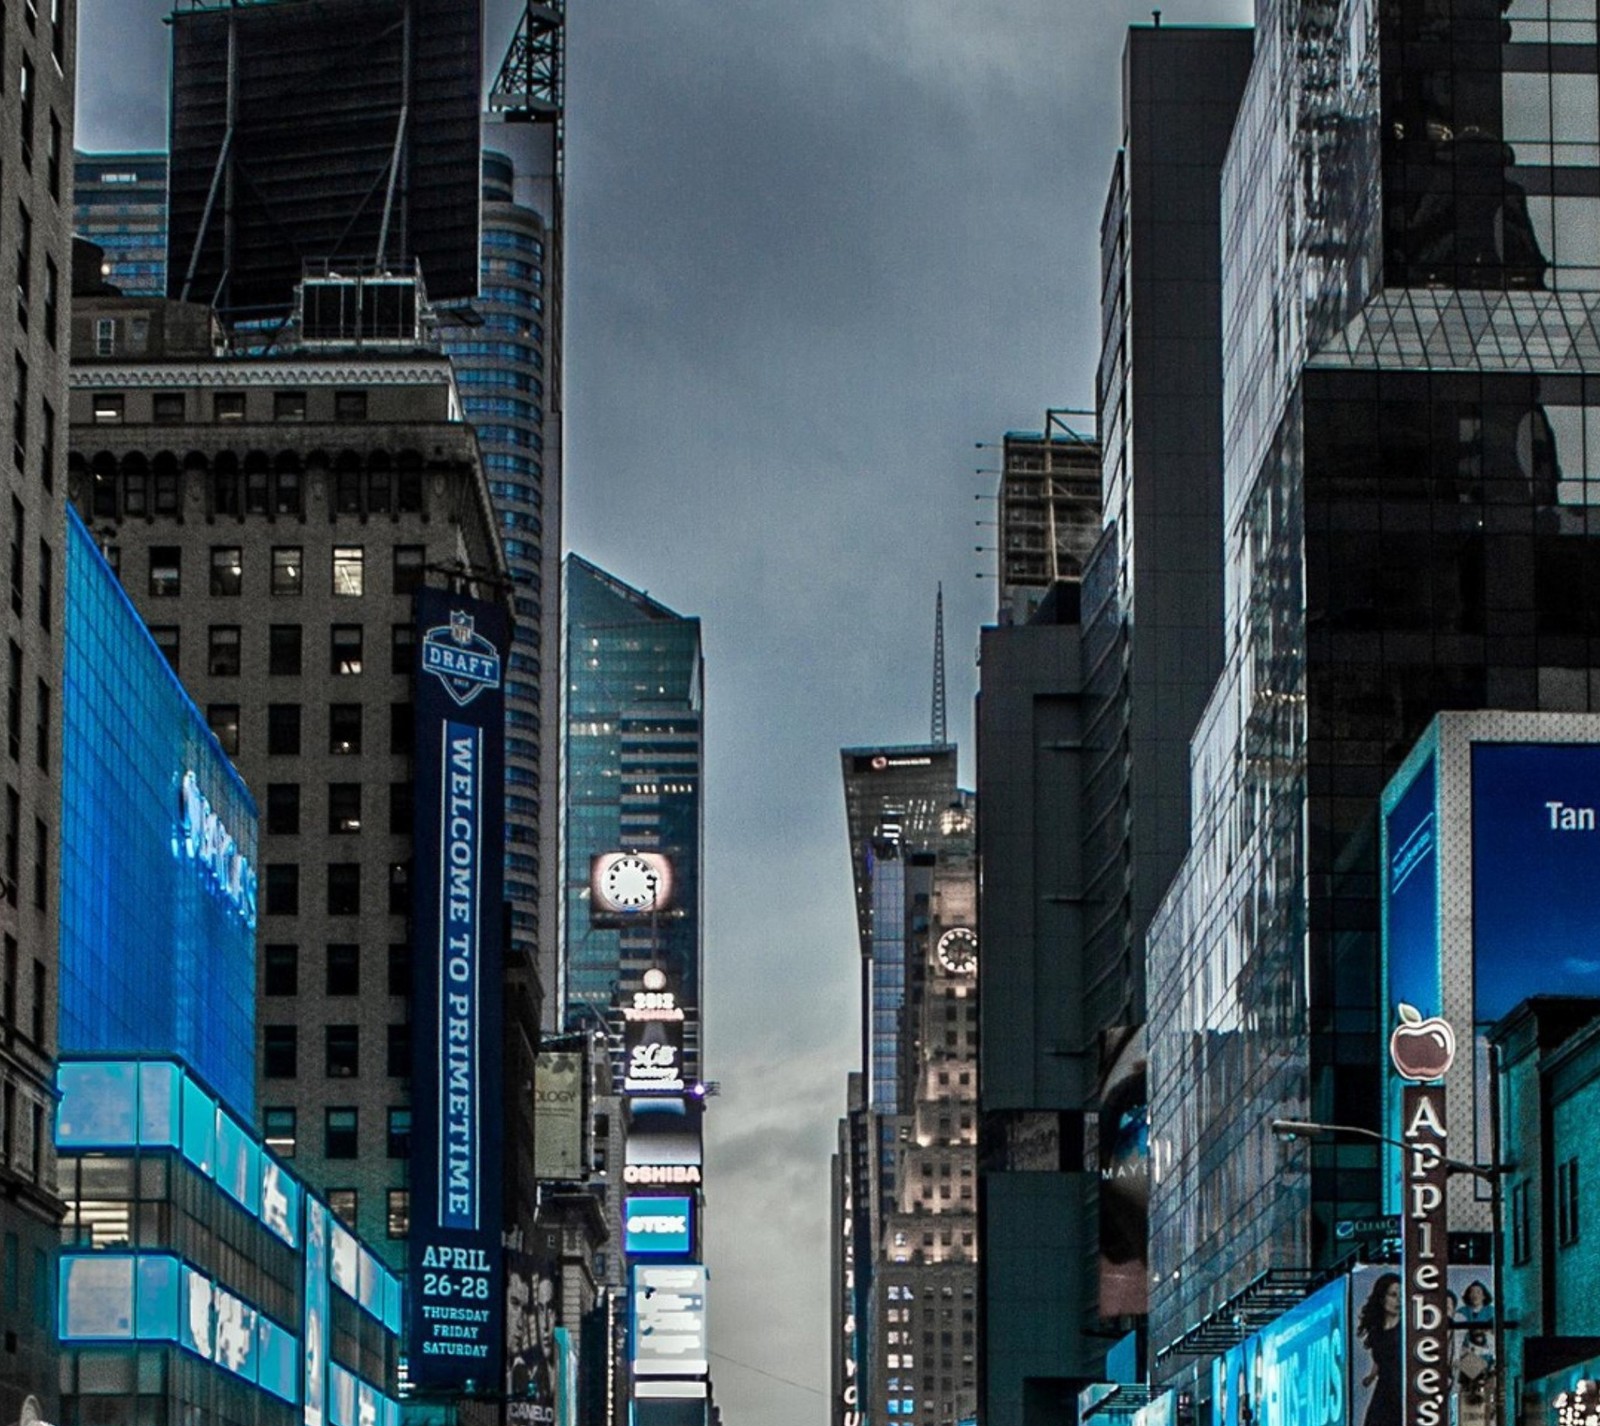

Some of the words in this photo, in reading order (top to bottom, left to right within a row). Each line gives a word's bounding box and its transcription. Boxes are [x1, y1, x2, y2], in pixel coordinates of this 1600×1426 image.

[430, 647, 493, 677] DRAFT
[1545, 801, 1596, 831] Tan
[450, 737, 473, 924] WELCOME
[449, 933, 471, 982] TO
[449, 992, 470, 1215] PRIMETIME
[422, 1246, 491, 1272] APRIL
[424, 1274, 489, 1299] 26-28
[422, 1306, 491, 1323] THURSDAY
[433, 1325, 479, 1339] FRIDAY
[423, 1341, 489, 1357] SATURDAY
